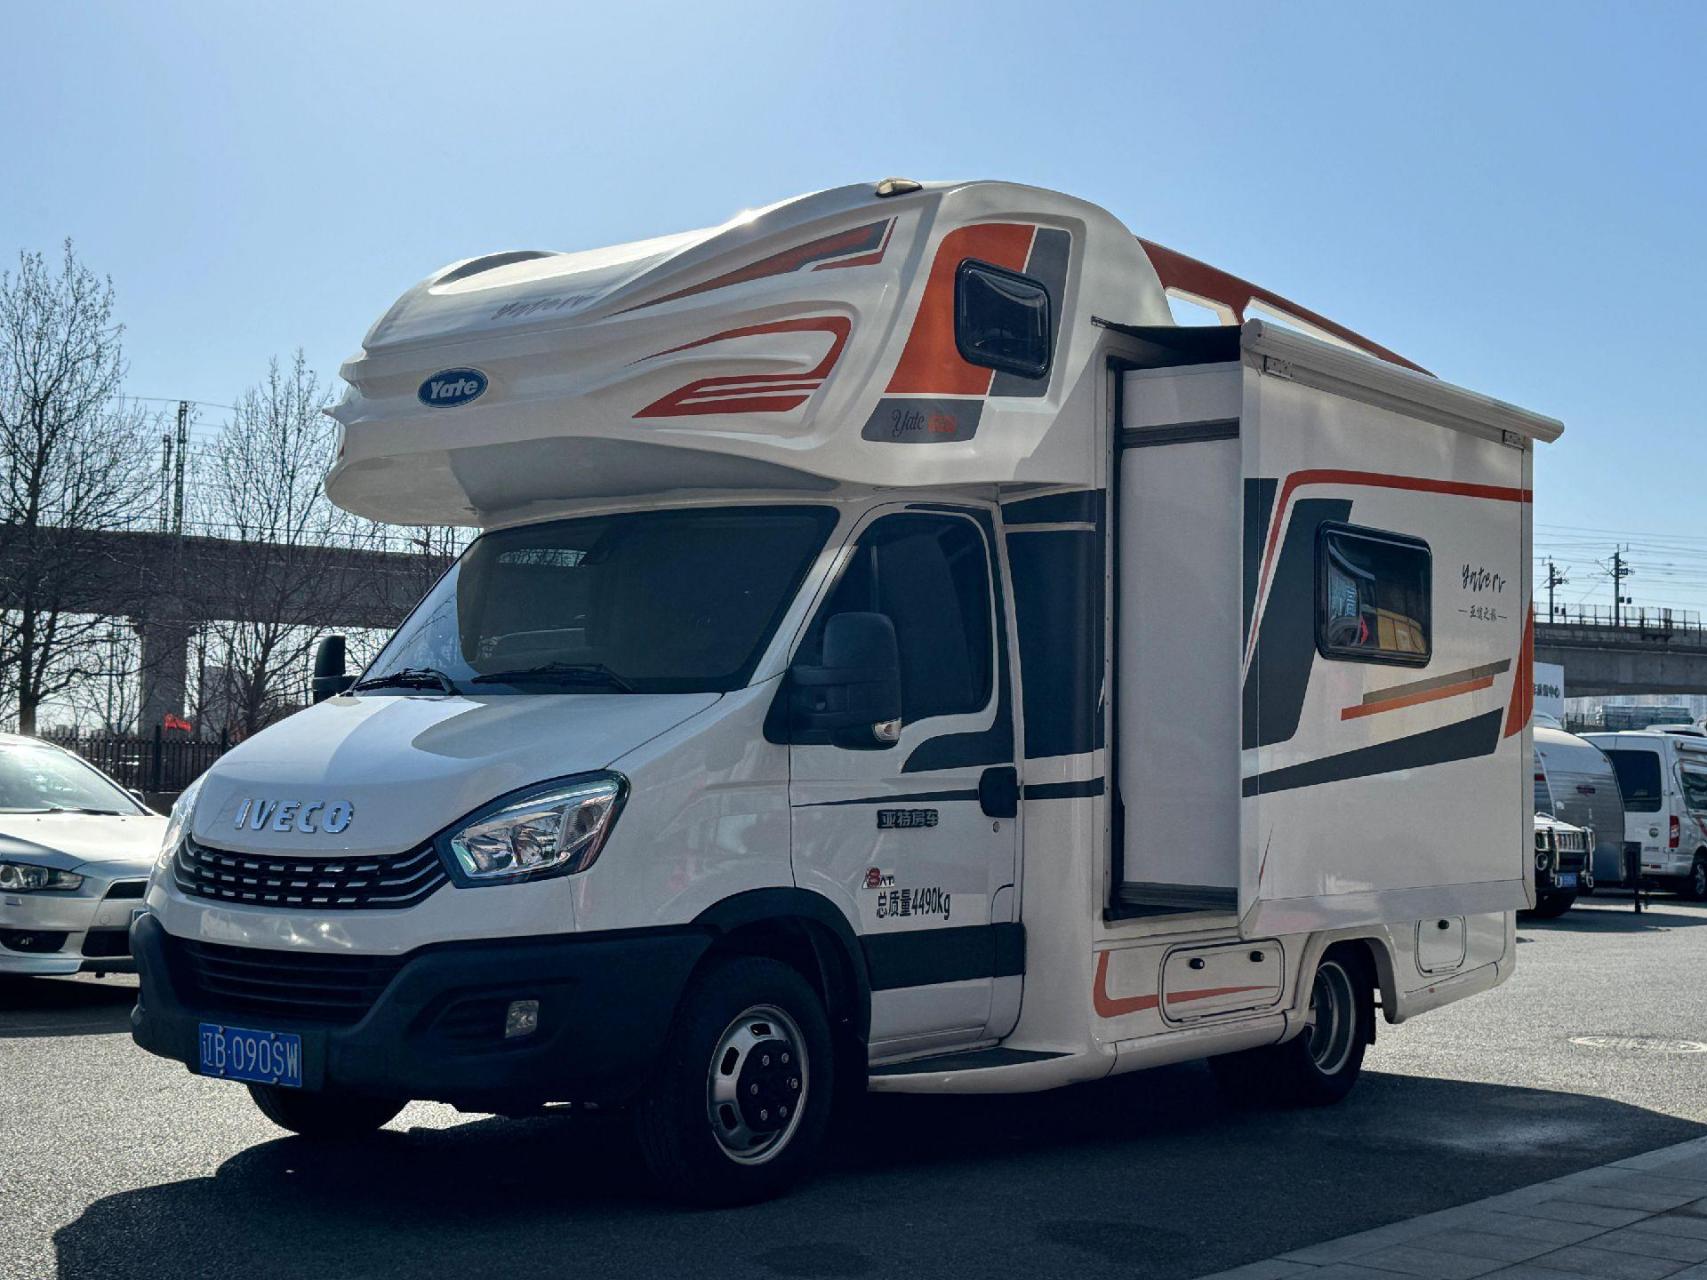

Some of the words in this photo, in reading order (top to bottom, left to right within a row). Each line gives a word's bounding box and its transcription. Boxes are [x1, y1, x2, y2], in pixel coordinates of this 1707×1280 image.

[430, 378, 479, 399] Yate
[891, 408, 925, 438] Yate
[234, 798, 354, 834] IVECO
[880, 810, 939, 828] 亚特房车
[876, 887, 951, 921] 总质量4490kg
